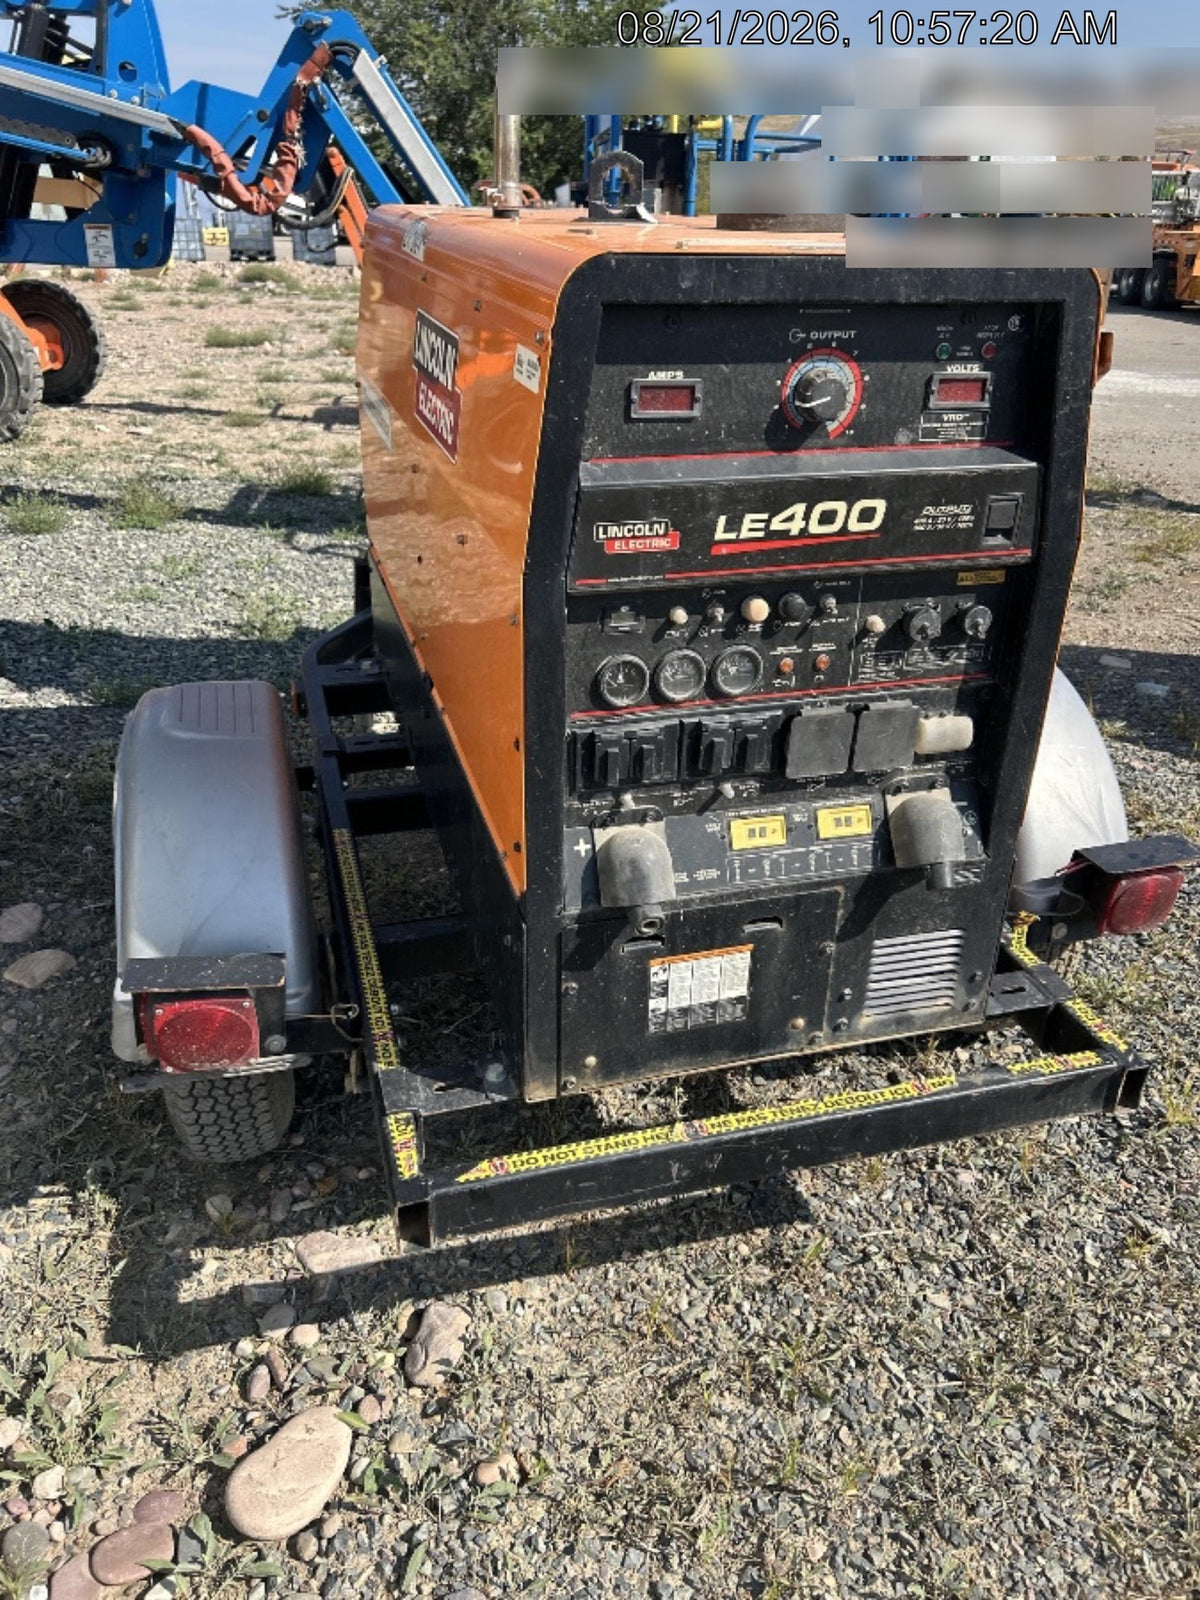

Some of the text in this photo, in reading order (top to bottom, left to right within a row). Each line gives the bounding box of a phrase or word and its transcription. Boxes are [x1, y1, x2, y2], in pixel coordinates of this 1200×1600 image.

[810, 330, 857, 340] OUTPUT
[414, 320, 456, 392] LINCOLN
[947, 364, 980, 372] VOLTS
[648, 370, 684, 379] AMPS
[418, 381, 455, 445] ELECTRIC
[598, 522, 666, 539] LINCOLN
[714, 499, 888, 541] LE400
[614, 537, 672, 550] ELECTRIC
[735, 1112, 768, 1125] PAS
[888, 1086, 911, 1096] ICI
[512, 1130, 676, 1168] DO NOT STAND HE
